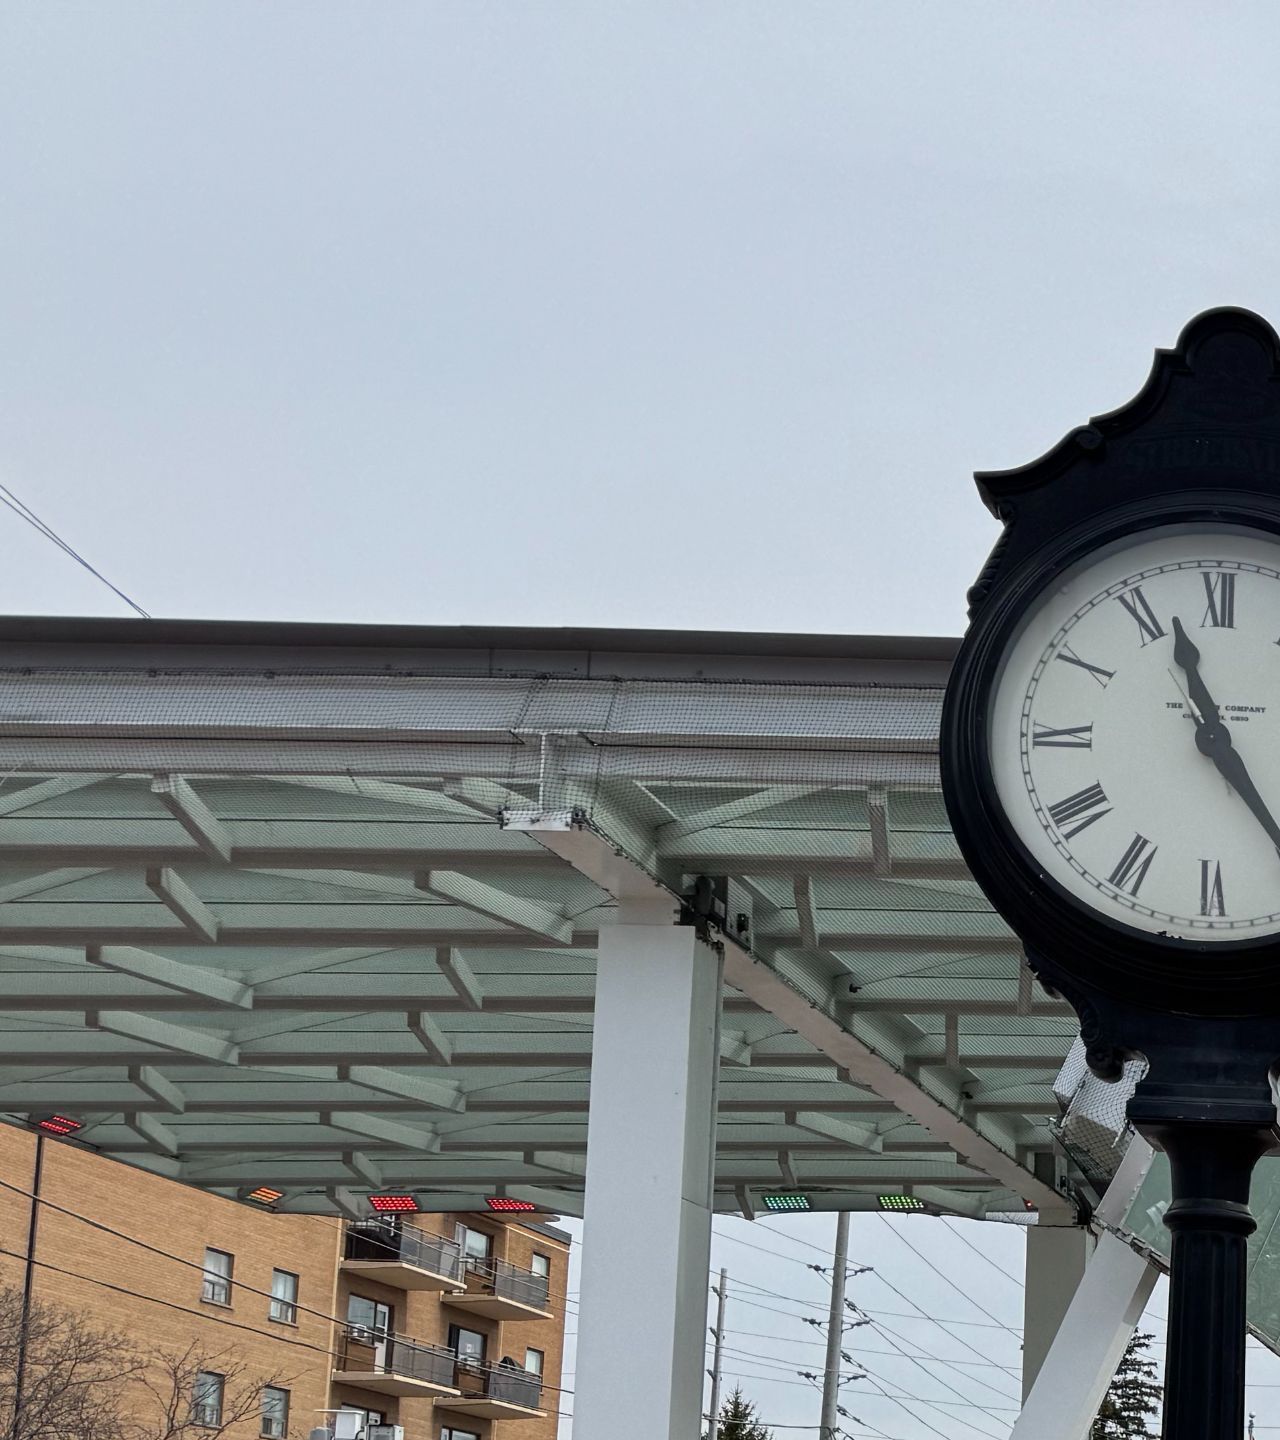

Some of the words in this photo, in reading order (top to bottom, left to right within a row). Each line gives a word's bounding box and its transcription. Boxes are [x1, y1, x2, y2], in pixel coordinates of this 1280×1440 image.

[1114, 584, 1168, 648] XI
[1201, 572, 1237, 629] XII
[1056, 643, 1117, 688] X
[1033, 721, 1093, 752] IX
[1225, 705, 1267, 713] COMPANY
[1047, 779, 1115, 842] VIII
[1105, 832, 1159, 898] VII
[1198, 858, 1228, 917] VI
